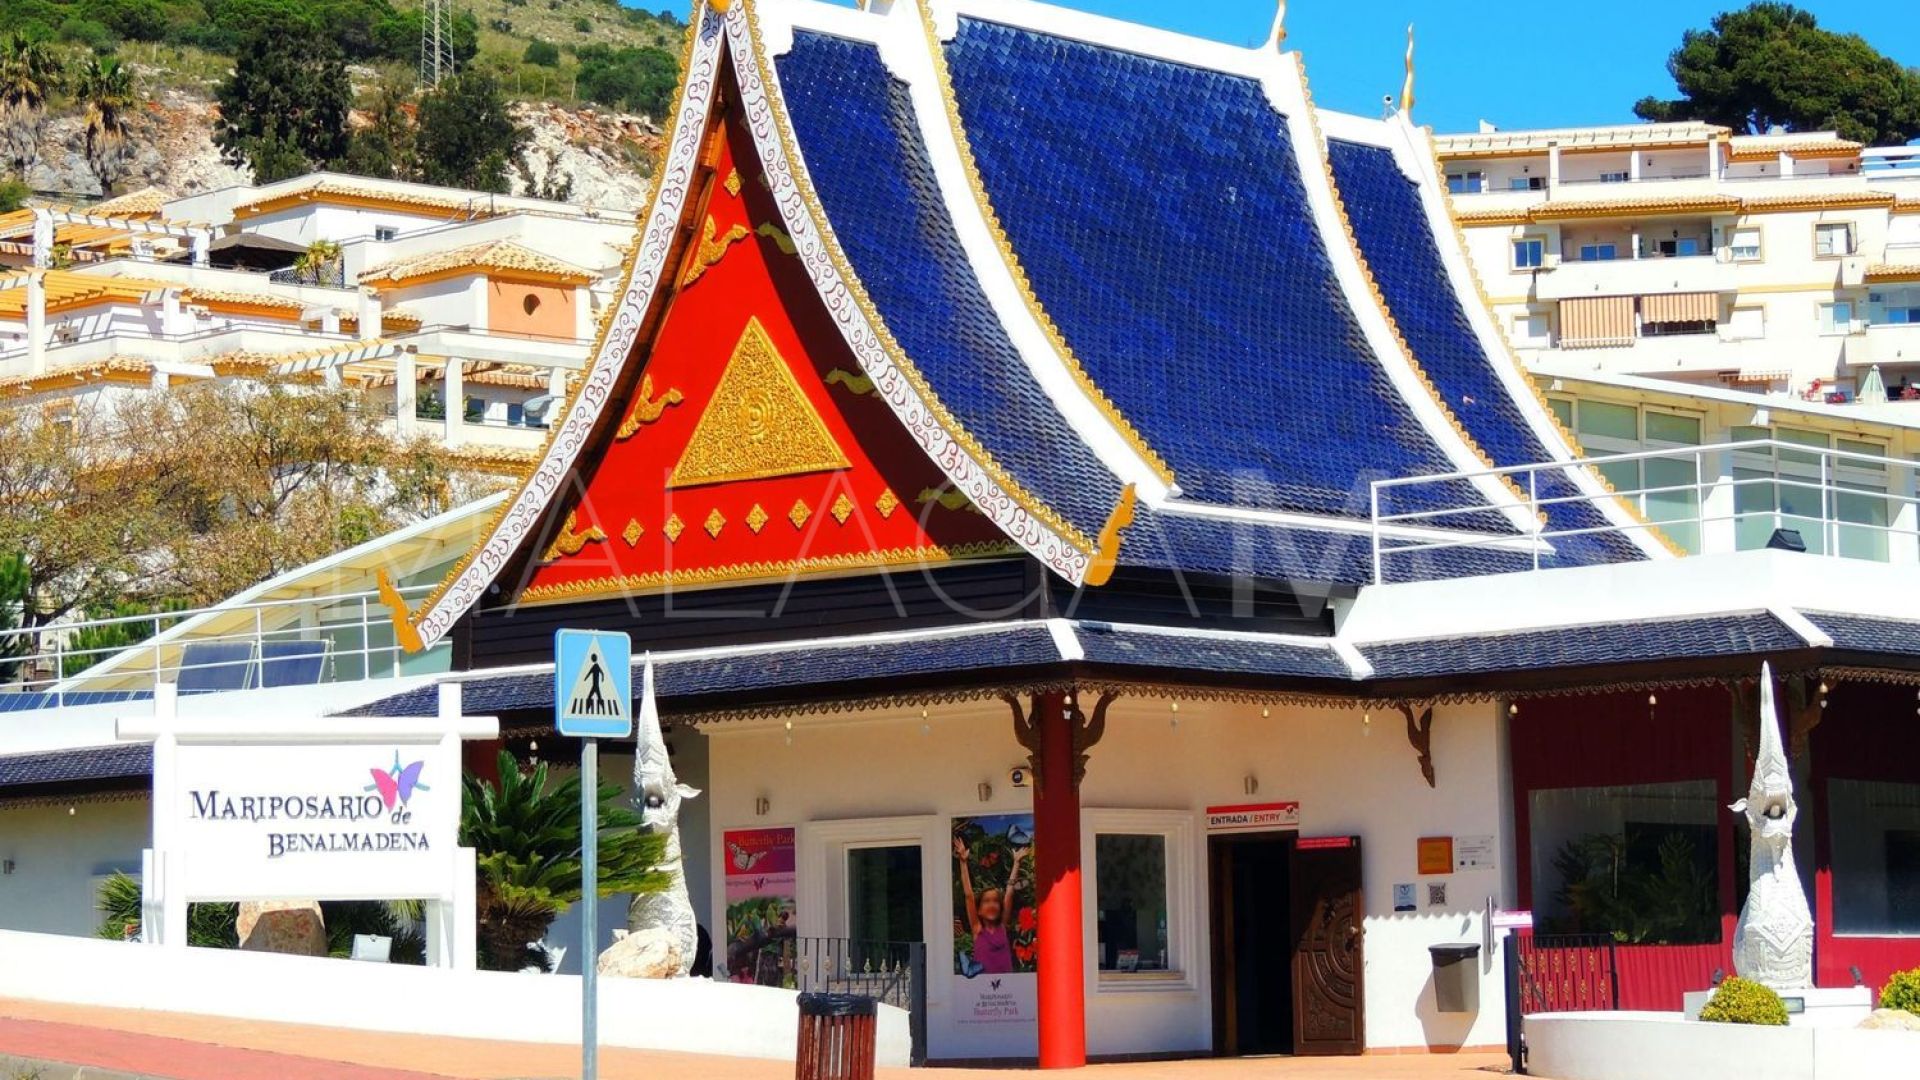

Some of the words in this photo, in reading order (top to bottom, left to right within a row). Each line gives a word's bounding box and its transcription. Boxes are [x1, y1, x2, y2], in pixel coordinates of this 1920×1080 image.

[188, 790, 384, 822] MARIPOSARIO
[391, 806, 412, 825] de
[1210, 815, 1248, 825] ENTRADA
[1254, 813, 1281, 823] ENTRY
[267, 832, 430, 858] BENALMADENA
